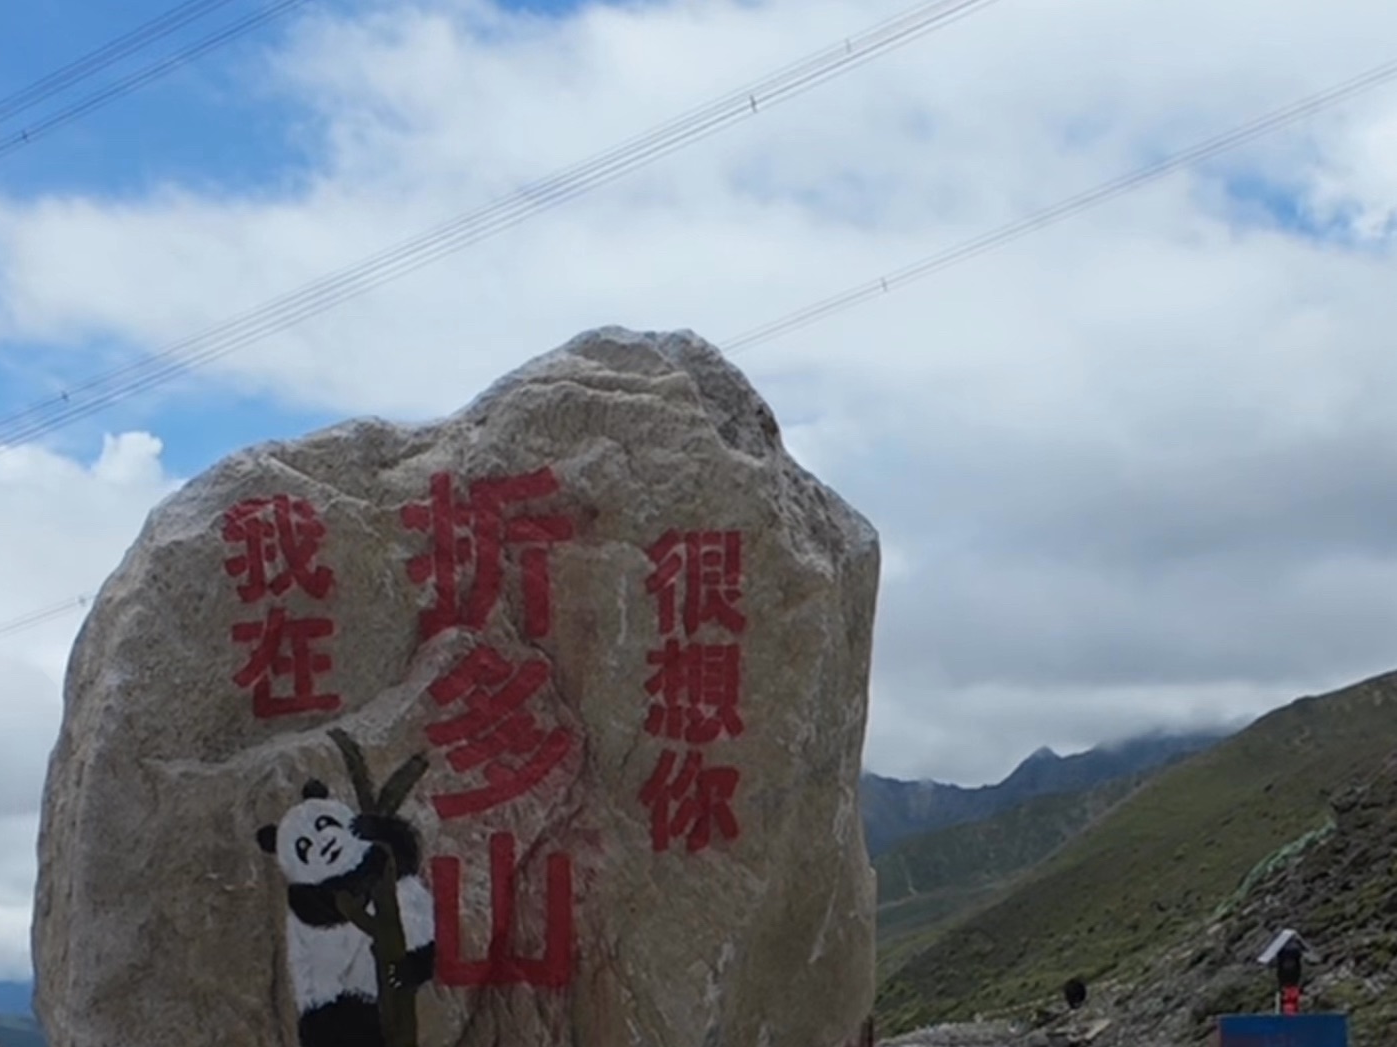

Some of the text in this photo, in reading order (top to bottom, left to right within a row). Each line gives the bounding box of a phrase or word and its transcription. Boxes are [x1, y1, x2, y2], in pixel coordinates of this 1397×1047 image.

[223, 494, 341, 718] 我在
[402, 467, 574, 987] 折多山
[640, 530, 745, 851] 很想你
